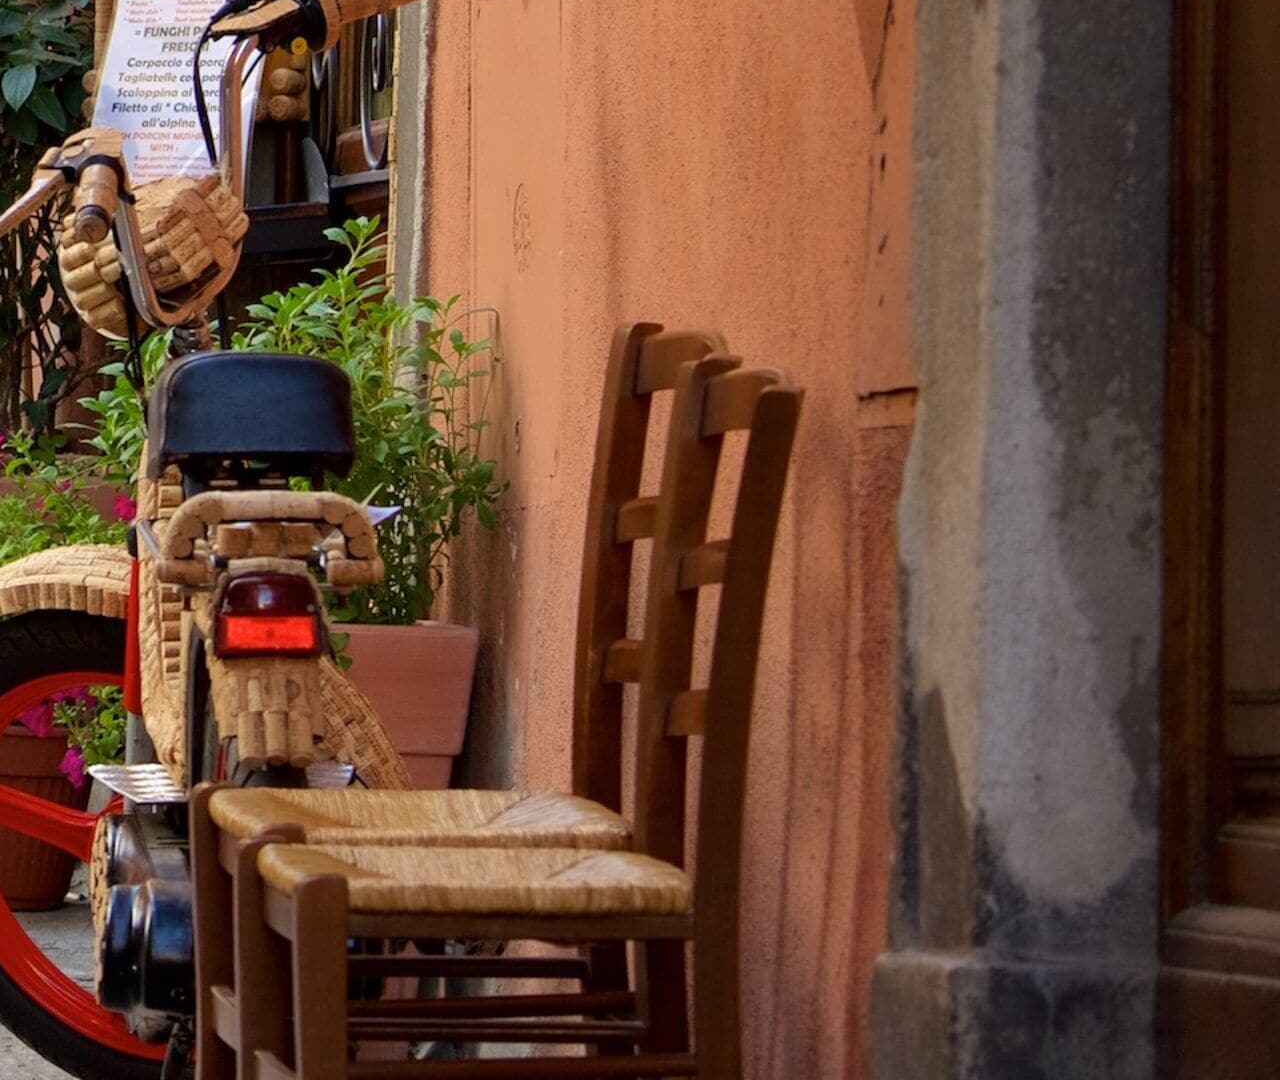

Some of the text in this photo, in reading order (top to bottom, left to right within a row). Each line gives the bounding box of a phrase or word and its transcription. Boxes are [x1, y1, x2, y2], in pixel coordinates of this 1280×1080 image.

[144, 27, 190, 37] FUNGHI
[128, 58, 182, 70] Carpaccio
[118, 72, 177, 84] Tagliatelle
[117, 88, 179, 99] Scaloppina
[112, 102, 162, 112] Filetto di
[142, 118, 196, 128] all'alpina
